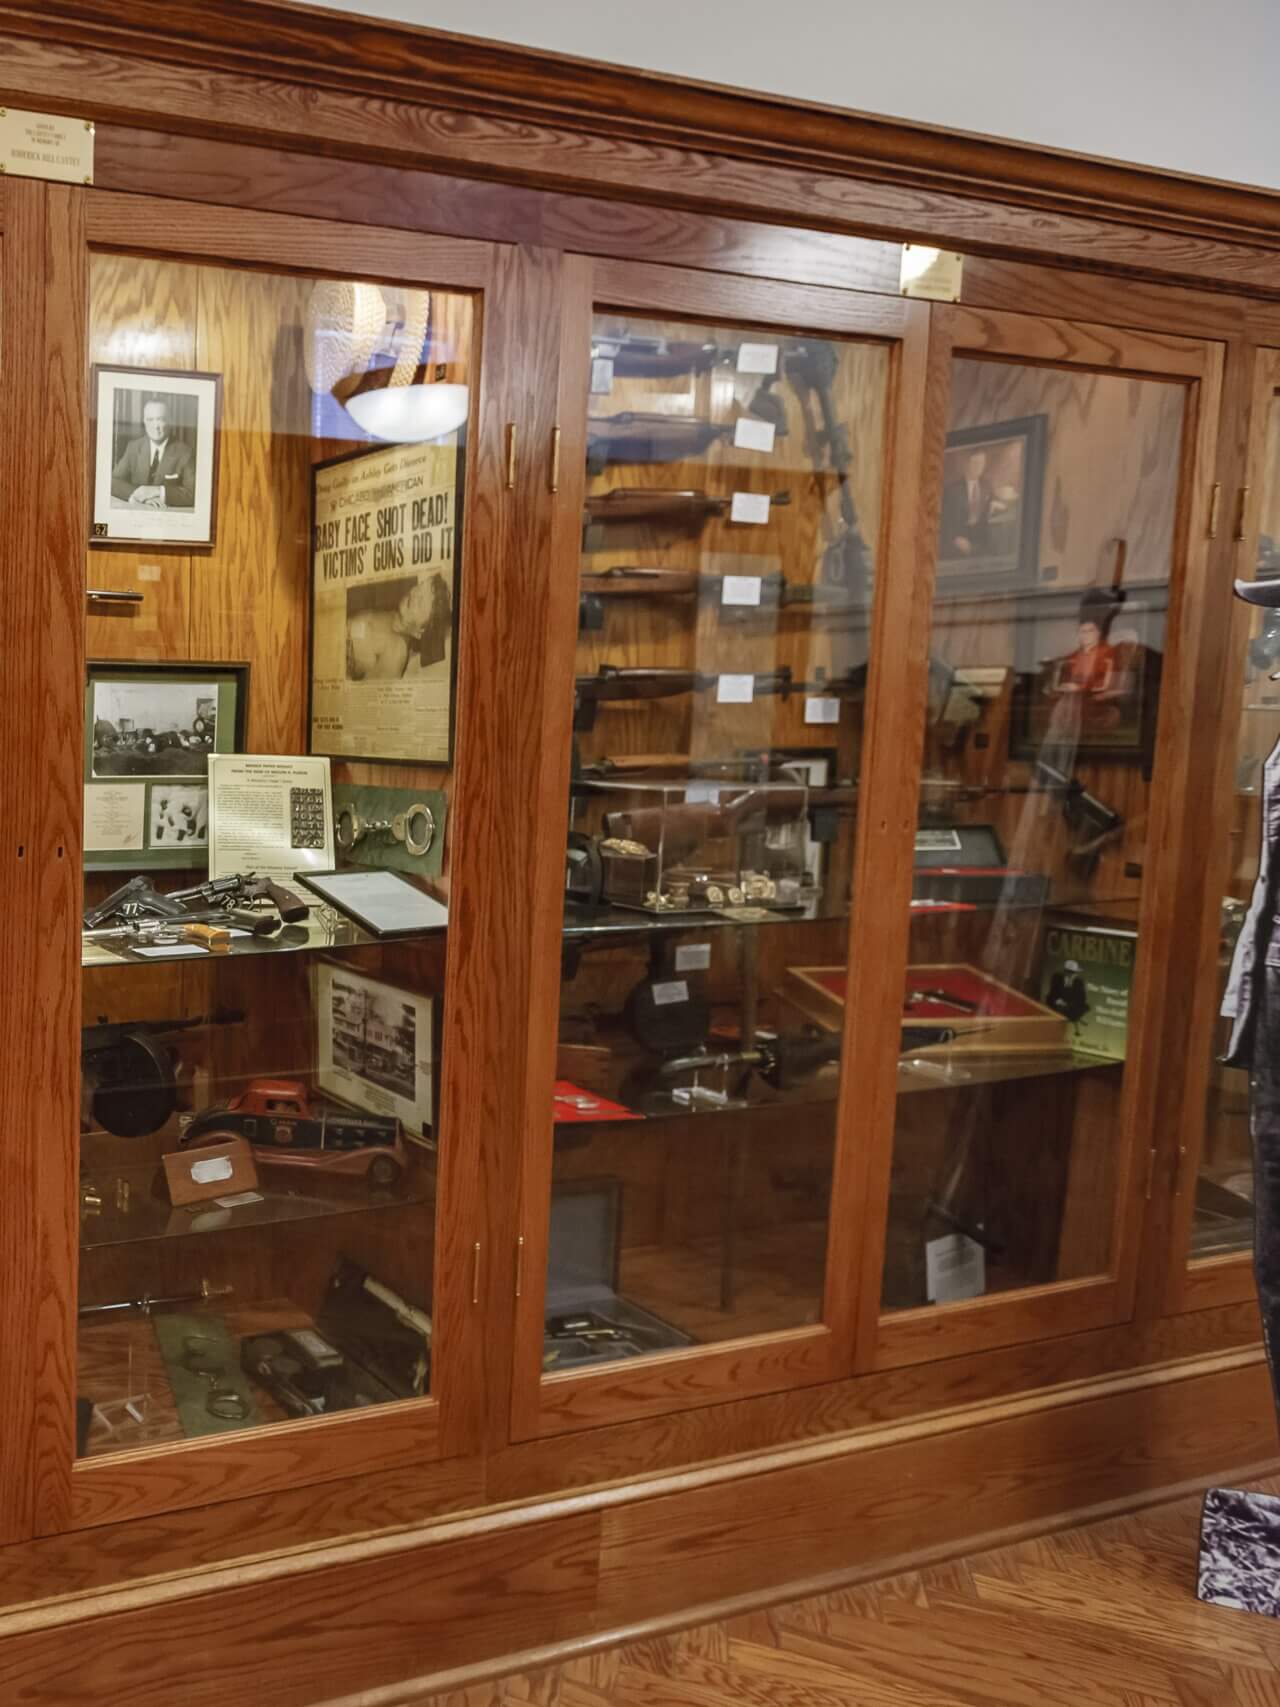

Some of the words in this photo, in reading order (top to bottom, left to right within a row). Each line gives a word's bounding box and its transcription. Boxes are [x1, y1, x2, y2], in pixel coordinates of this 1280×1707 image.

[316, 519, 341, 552] BABY
[344, 512, 372, 547] FACE
[376, 502, 408, 540] SHOT
[411, 492, 449, 531] DEAD!
[322, 545, 368, 582] VICTIMS'
[373, 537, 404, 573] GUNS
[411, 531, 433, 566] DID
[440, 527, 453, 560] IT
[123, 903, 138, 915] 77
[221, 894, 236, 912] 78
[1047, 930, 1132, 968] CARBINE
